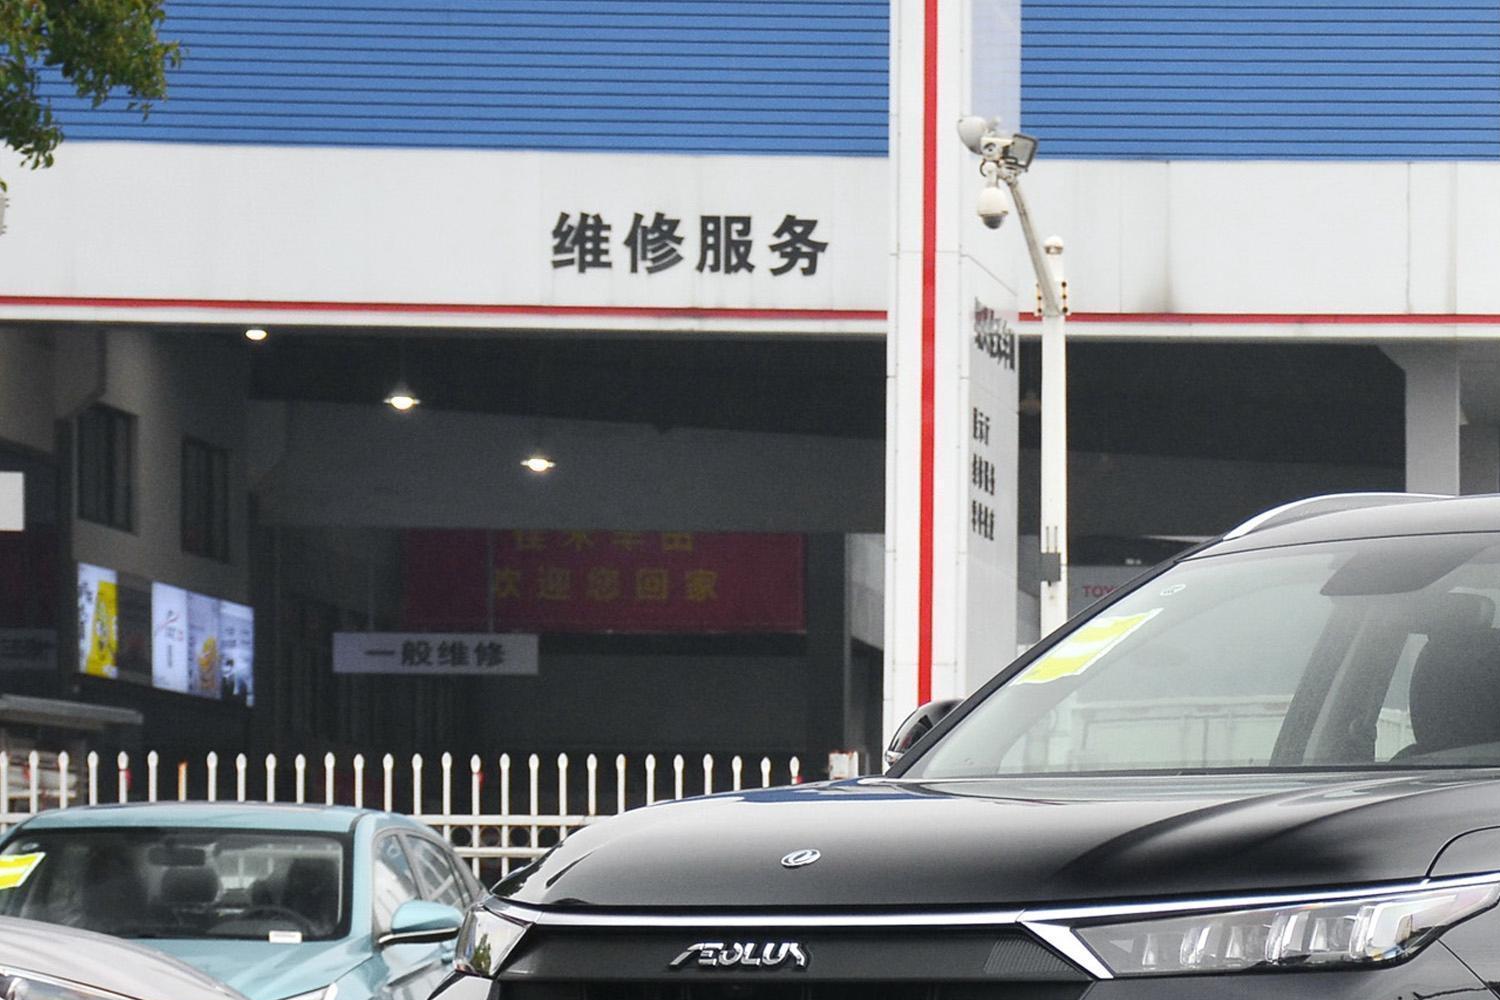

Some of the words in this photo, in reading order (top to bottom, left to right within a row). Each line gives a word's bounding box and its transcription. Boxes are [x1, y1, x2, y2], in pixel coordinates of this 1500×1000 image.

[552, 211, 829, 276] 维修服务
[364, 639, 506, 667] 一般维修
